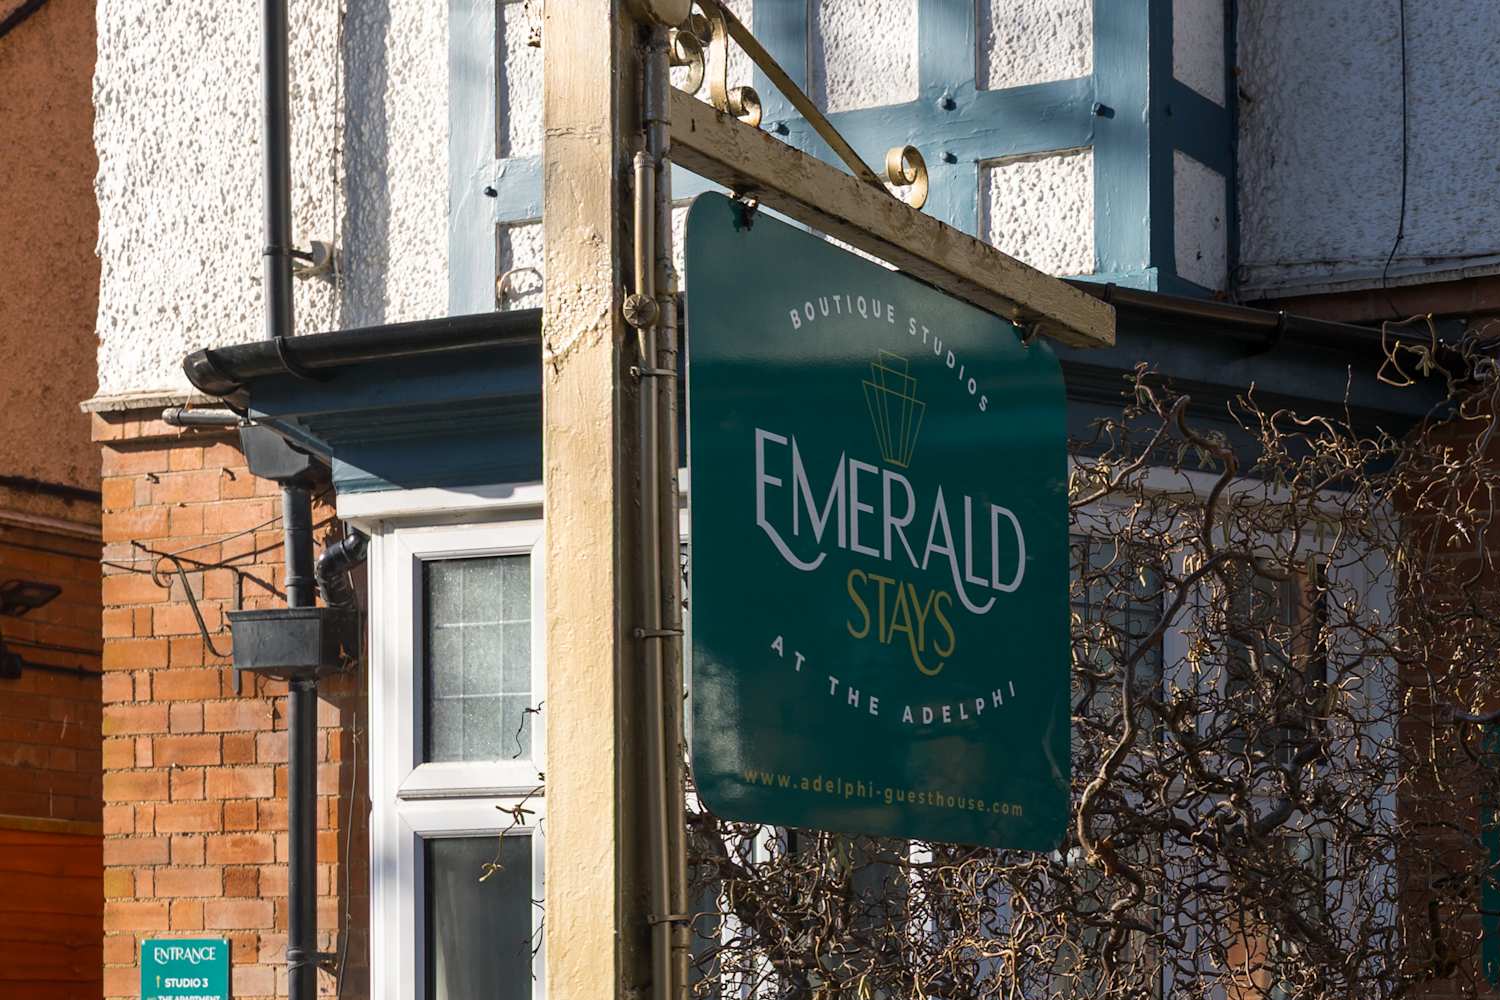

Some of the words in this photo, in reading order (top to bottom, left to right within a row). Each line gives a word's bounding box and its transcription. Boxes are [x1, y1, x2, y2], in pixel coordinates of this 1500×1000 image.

[789, 295, 895, 329] BOUTIQUE
[909, 317, 988, 412] STUDIOS
[754, 427, 1027, 616] EMERALD
[846, 568, 956, 677] STAYS
[771, 635, 806, 672] AT
[828, 676, 880, 716] THE
[902, 681, 1016, 725] ADELPHI
[744, 768, 1024, 817] www.adelphi-guesthouse.com
[153, 946, 216, 965] ENTRANCE
[164, 978, 200, 988] STUDIO
[202, 978, 209, 988] 3
